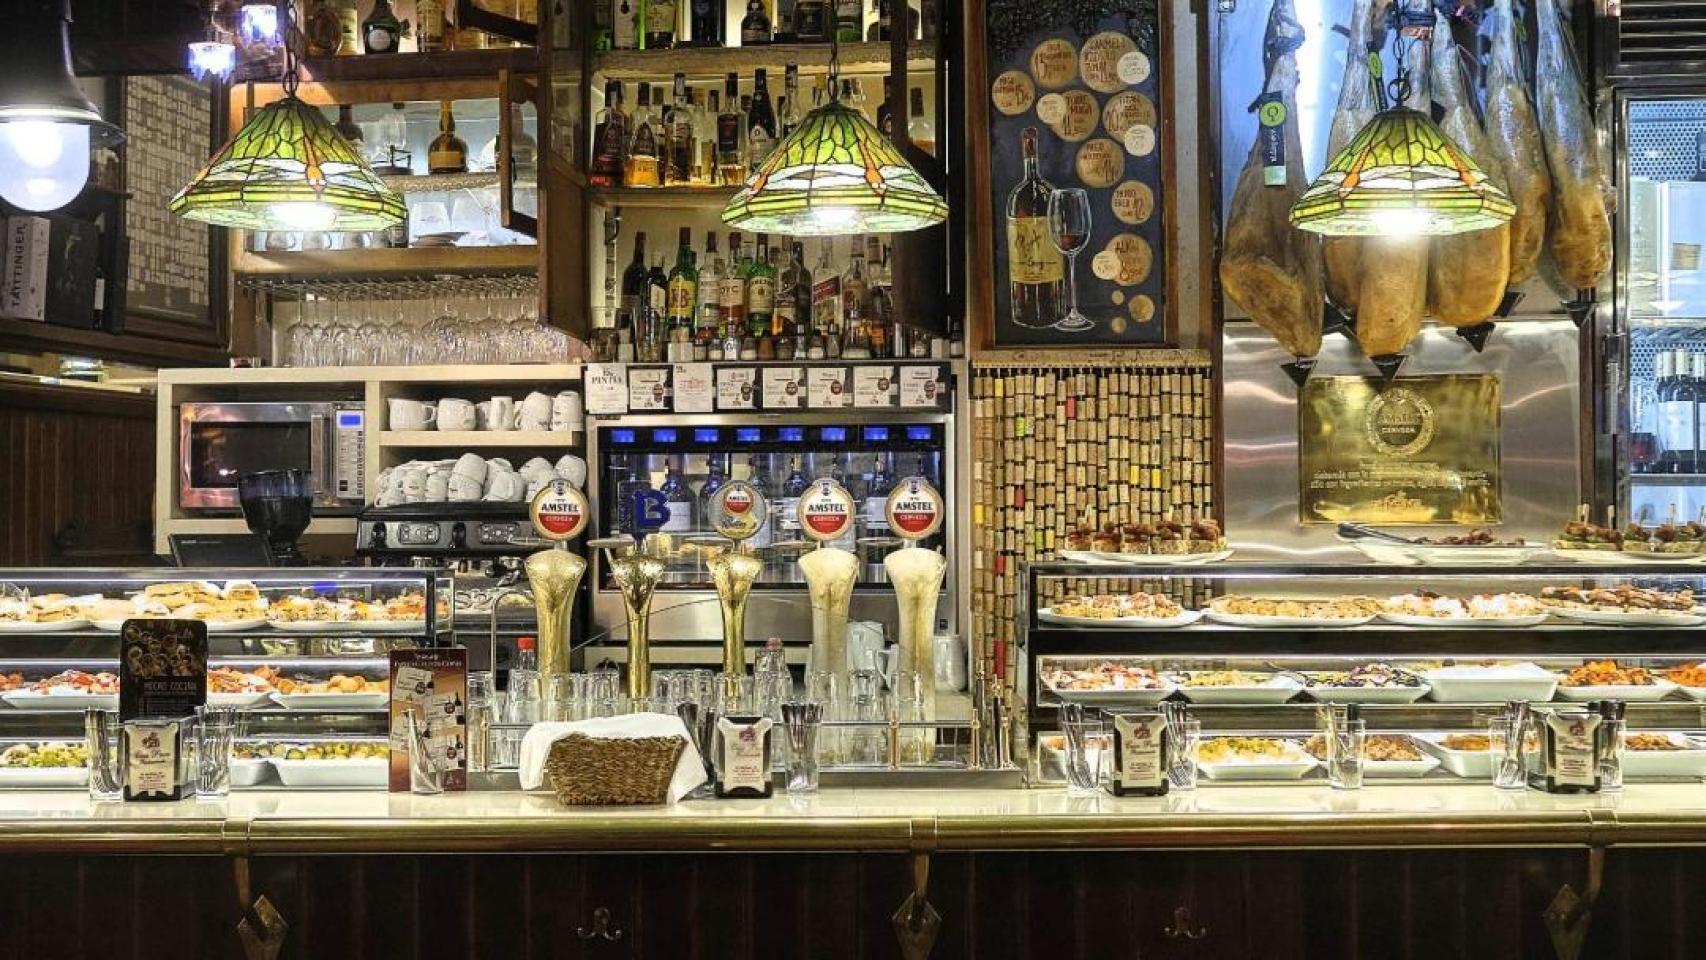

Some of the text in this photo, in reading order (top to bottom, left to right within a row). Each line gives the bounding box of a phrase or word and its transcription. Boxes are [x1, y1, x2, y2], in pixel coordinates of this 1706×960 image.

[541, 503, 578, 512] AMSTEL
[808, 503, 845, 512] AMSTEL
[896, 502, 933, 511] AMSTEL
